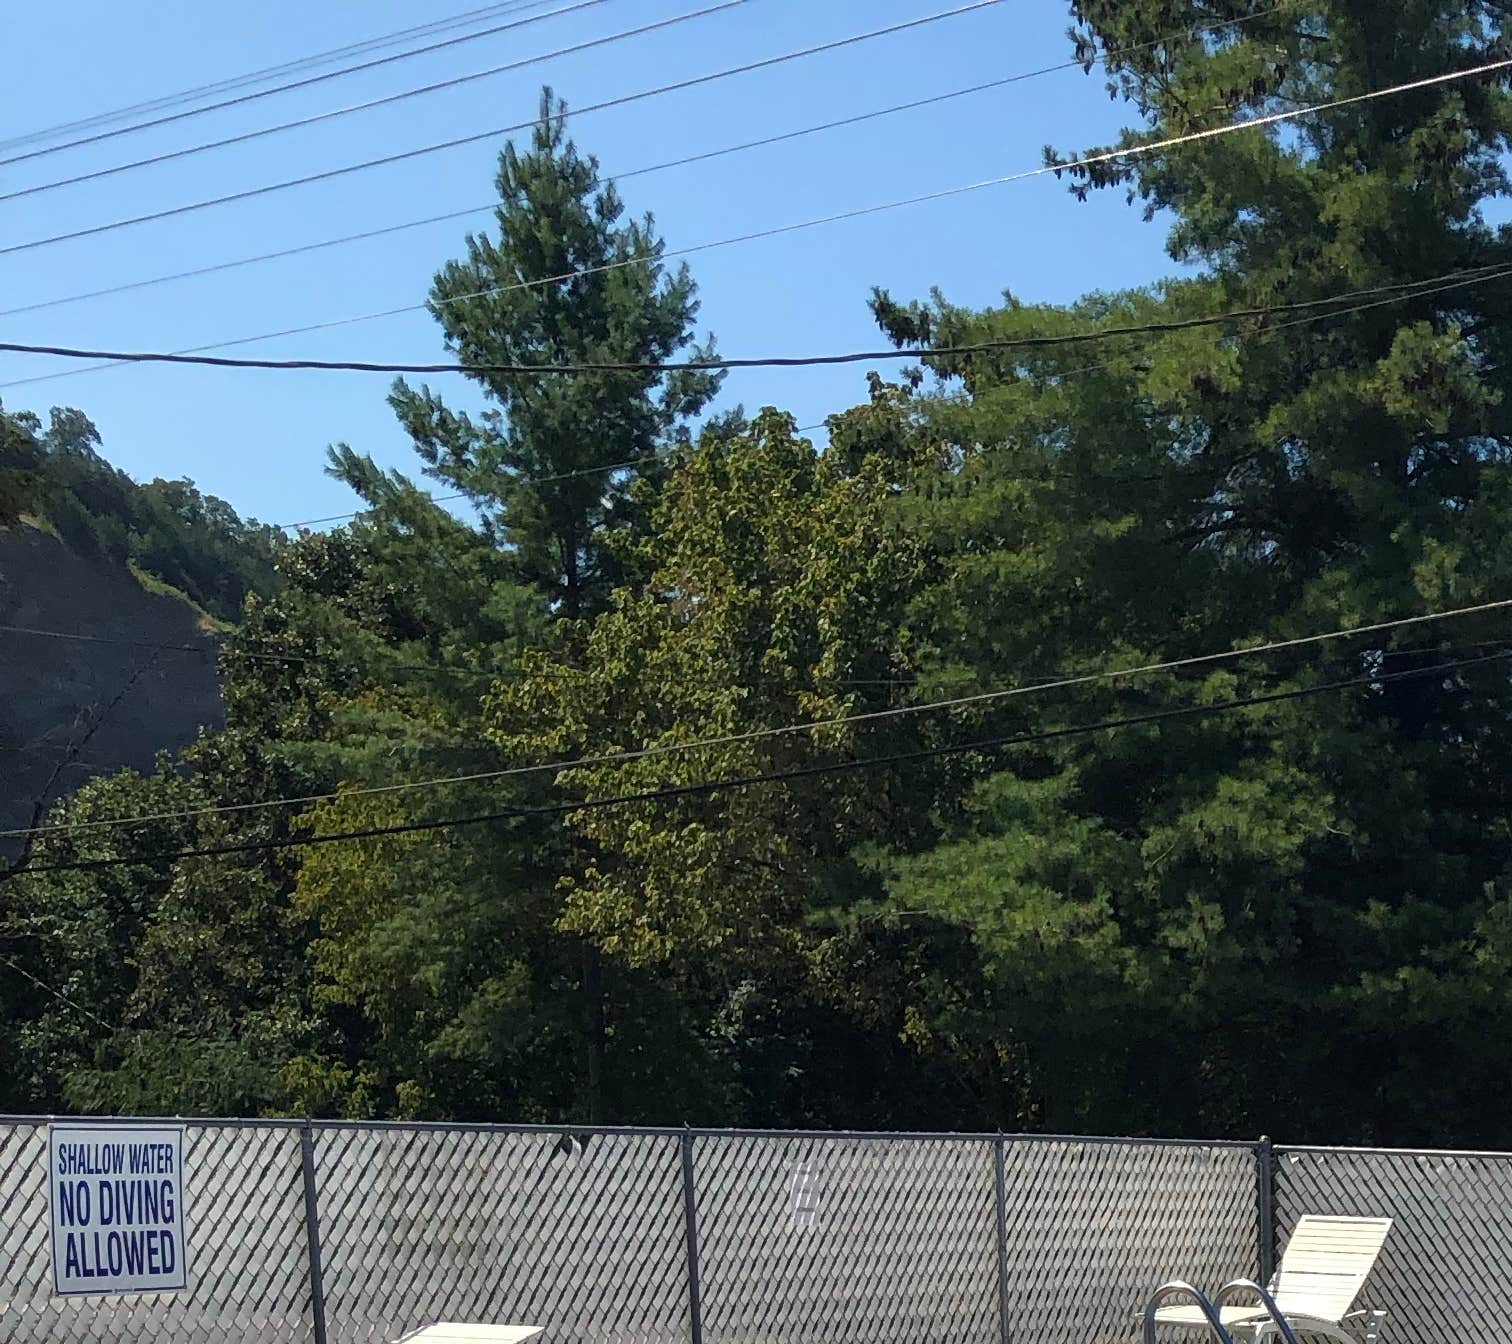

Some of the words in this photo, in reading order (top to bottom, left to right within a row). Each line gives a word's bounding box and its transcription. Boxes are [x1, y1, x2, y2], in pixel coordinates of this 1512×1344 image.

[58, 1144, 125, 1175] SHALLOW
[129, 1143, 174, 1174] WATER
[59, 1180, 91, 1226] NO
[100, 1179, 175, 1225] DIVING
[65, 1230, 175, 1278] ALLOWED
